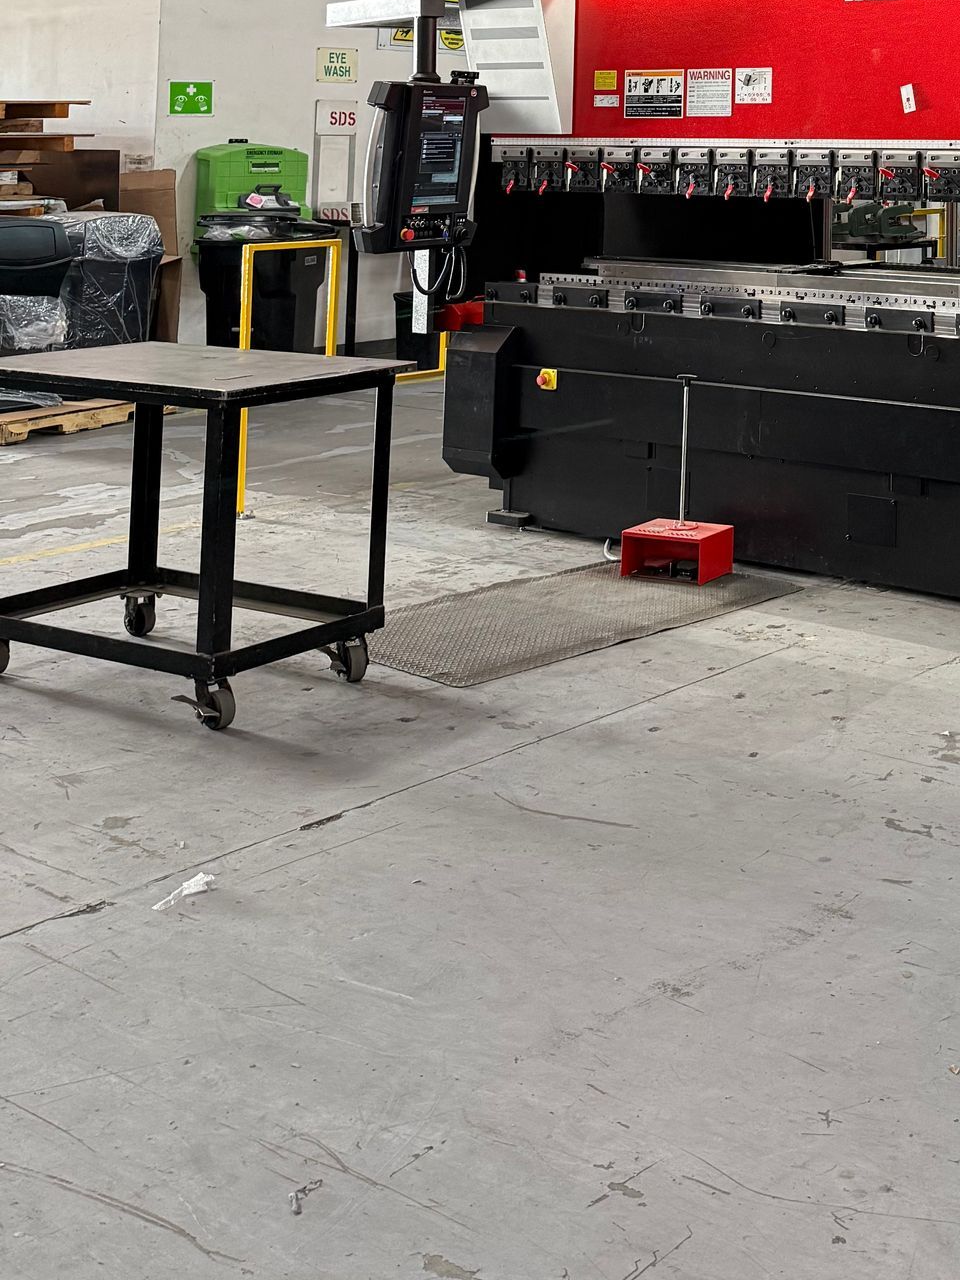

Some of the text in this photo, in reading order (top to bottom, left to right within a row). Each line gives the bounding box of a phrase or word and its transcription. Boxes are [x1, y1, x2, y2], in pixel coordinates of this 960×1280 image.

[328, 52, 347, 64] EYE
[323, 65, 351, 77] WASH
[688, 70, 731, 81] WARNING
[329, 111, 356, 126] SDS
[322, 207, 349, 220] SDS
